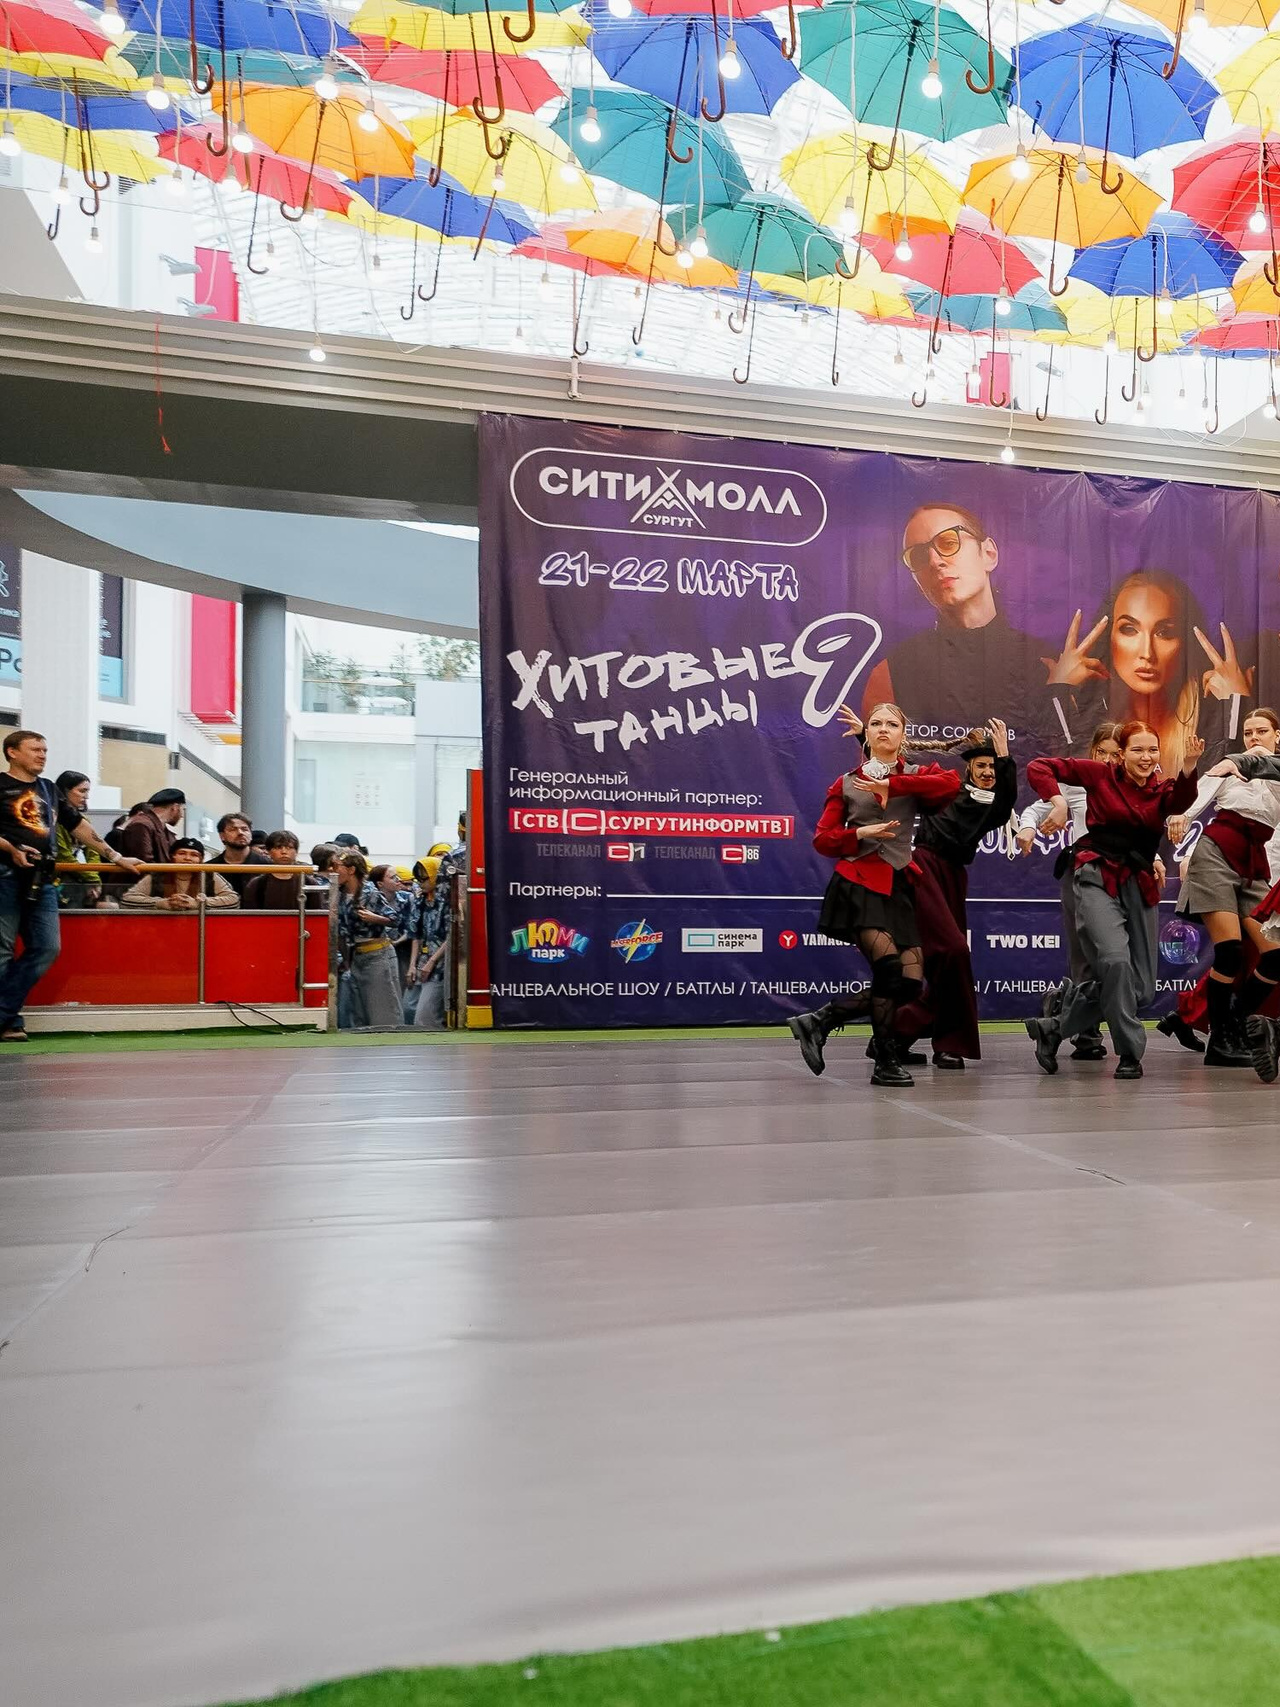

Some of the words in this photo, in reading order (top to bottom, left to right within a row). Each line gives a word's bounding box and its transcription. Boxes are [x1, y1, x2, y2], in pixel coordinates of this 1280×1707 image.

[538, 466, 649, 499] СИТИ
[686, 480, 802, 516] МОЛЛ
[642, 513, 694, 528] СУРГУТ
[538, 550, 669, 593] 21-22
[677, 558, 799, 602] МАРТА
[905, 724, 938, 737] ЕГОР
[508, 767, 629, 786] Генеральный
[508, 785, 681, 803] информационный
[685, 793, 763, 807] партнер:
[536, 842, 601, 858] ТЕЛЕКАНАЛ
[654, 845, 716, 860] ТЕЛЕКАНАЛ
[508, 882, 602, 899] Партнеры:
[986, 935, 1028, 948] TWO
[1032, 935, 1061, 948] KEI
[532, 949, 566, 960] парк
[490, 983, 614, 998] АНЦЕВАЛЬНОЕ
[619, 982, 660, 996] ШОУ
